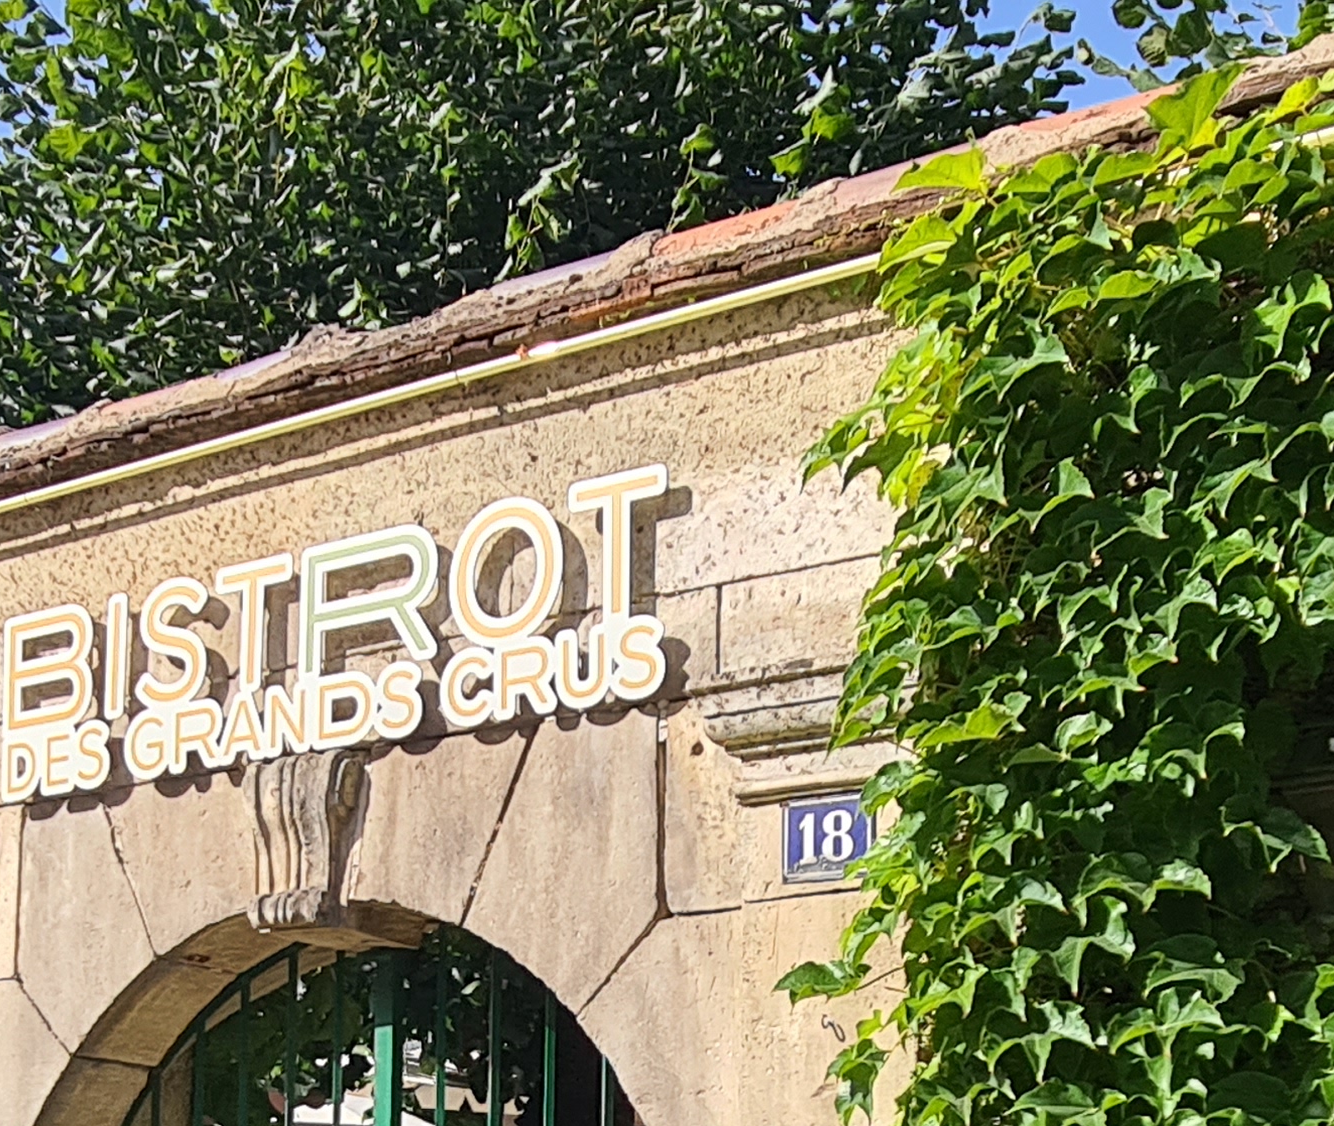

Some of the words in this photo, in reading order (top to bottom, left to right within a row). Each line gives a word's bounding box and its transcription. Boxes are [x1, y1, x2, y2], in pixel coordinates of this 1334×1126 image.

[3, 463, 667, 735] BISTROT
[2, 719, 110, 802] DES
[124, 660, 423, 779] GRANDS
[440, 614, 666, 728] CRUS
[798, 809, 855, 866] 18
